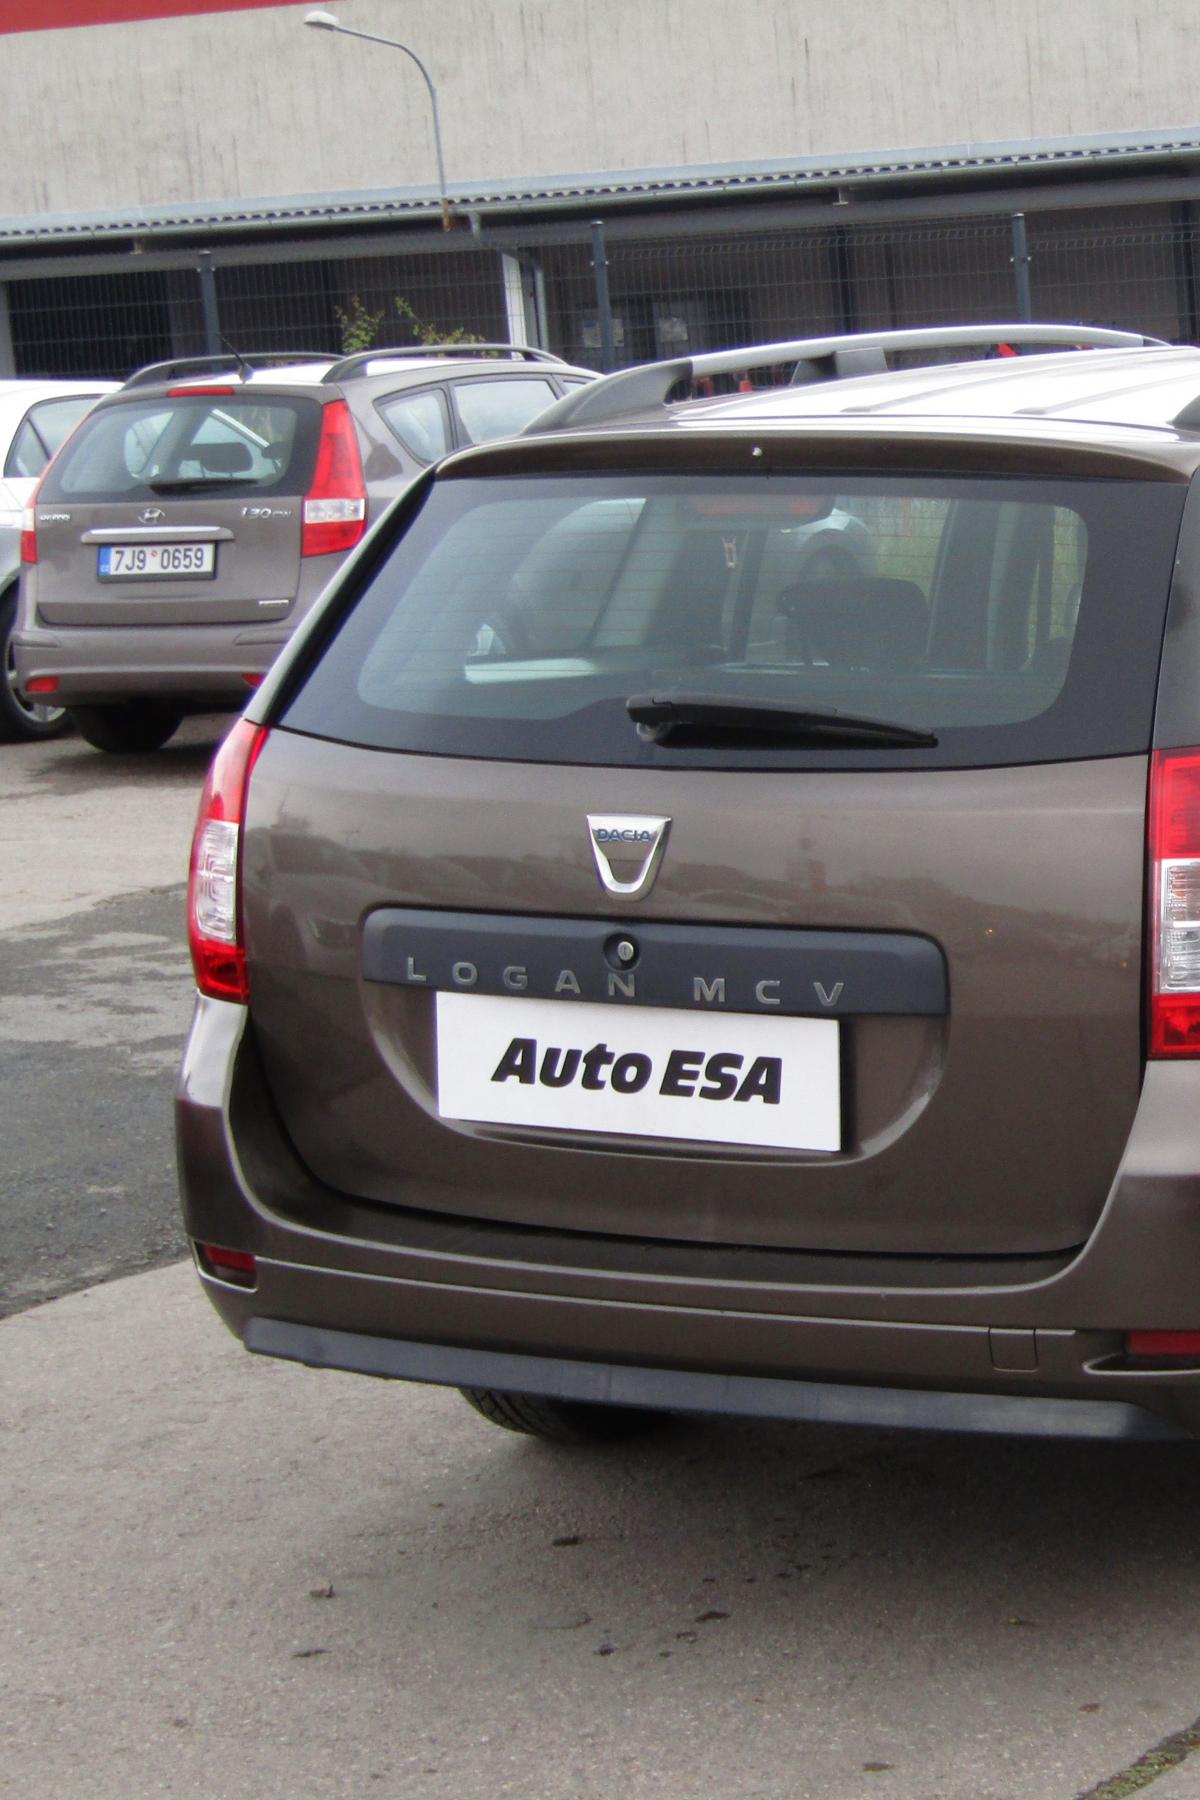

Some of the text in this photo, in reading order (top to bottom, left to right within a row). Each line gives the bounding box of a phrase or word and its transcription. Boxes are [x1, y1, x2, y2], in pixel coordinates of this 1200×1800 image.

[115, 548, 204, 572] 7J9 0659
[597, 828, 651, 842] DACIA
[407, 956, 844, 1006] LOGAN MCV
[491, 1038, 782, 1104] Auto ESA
